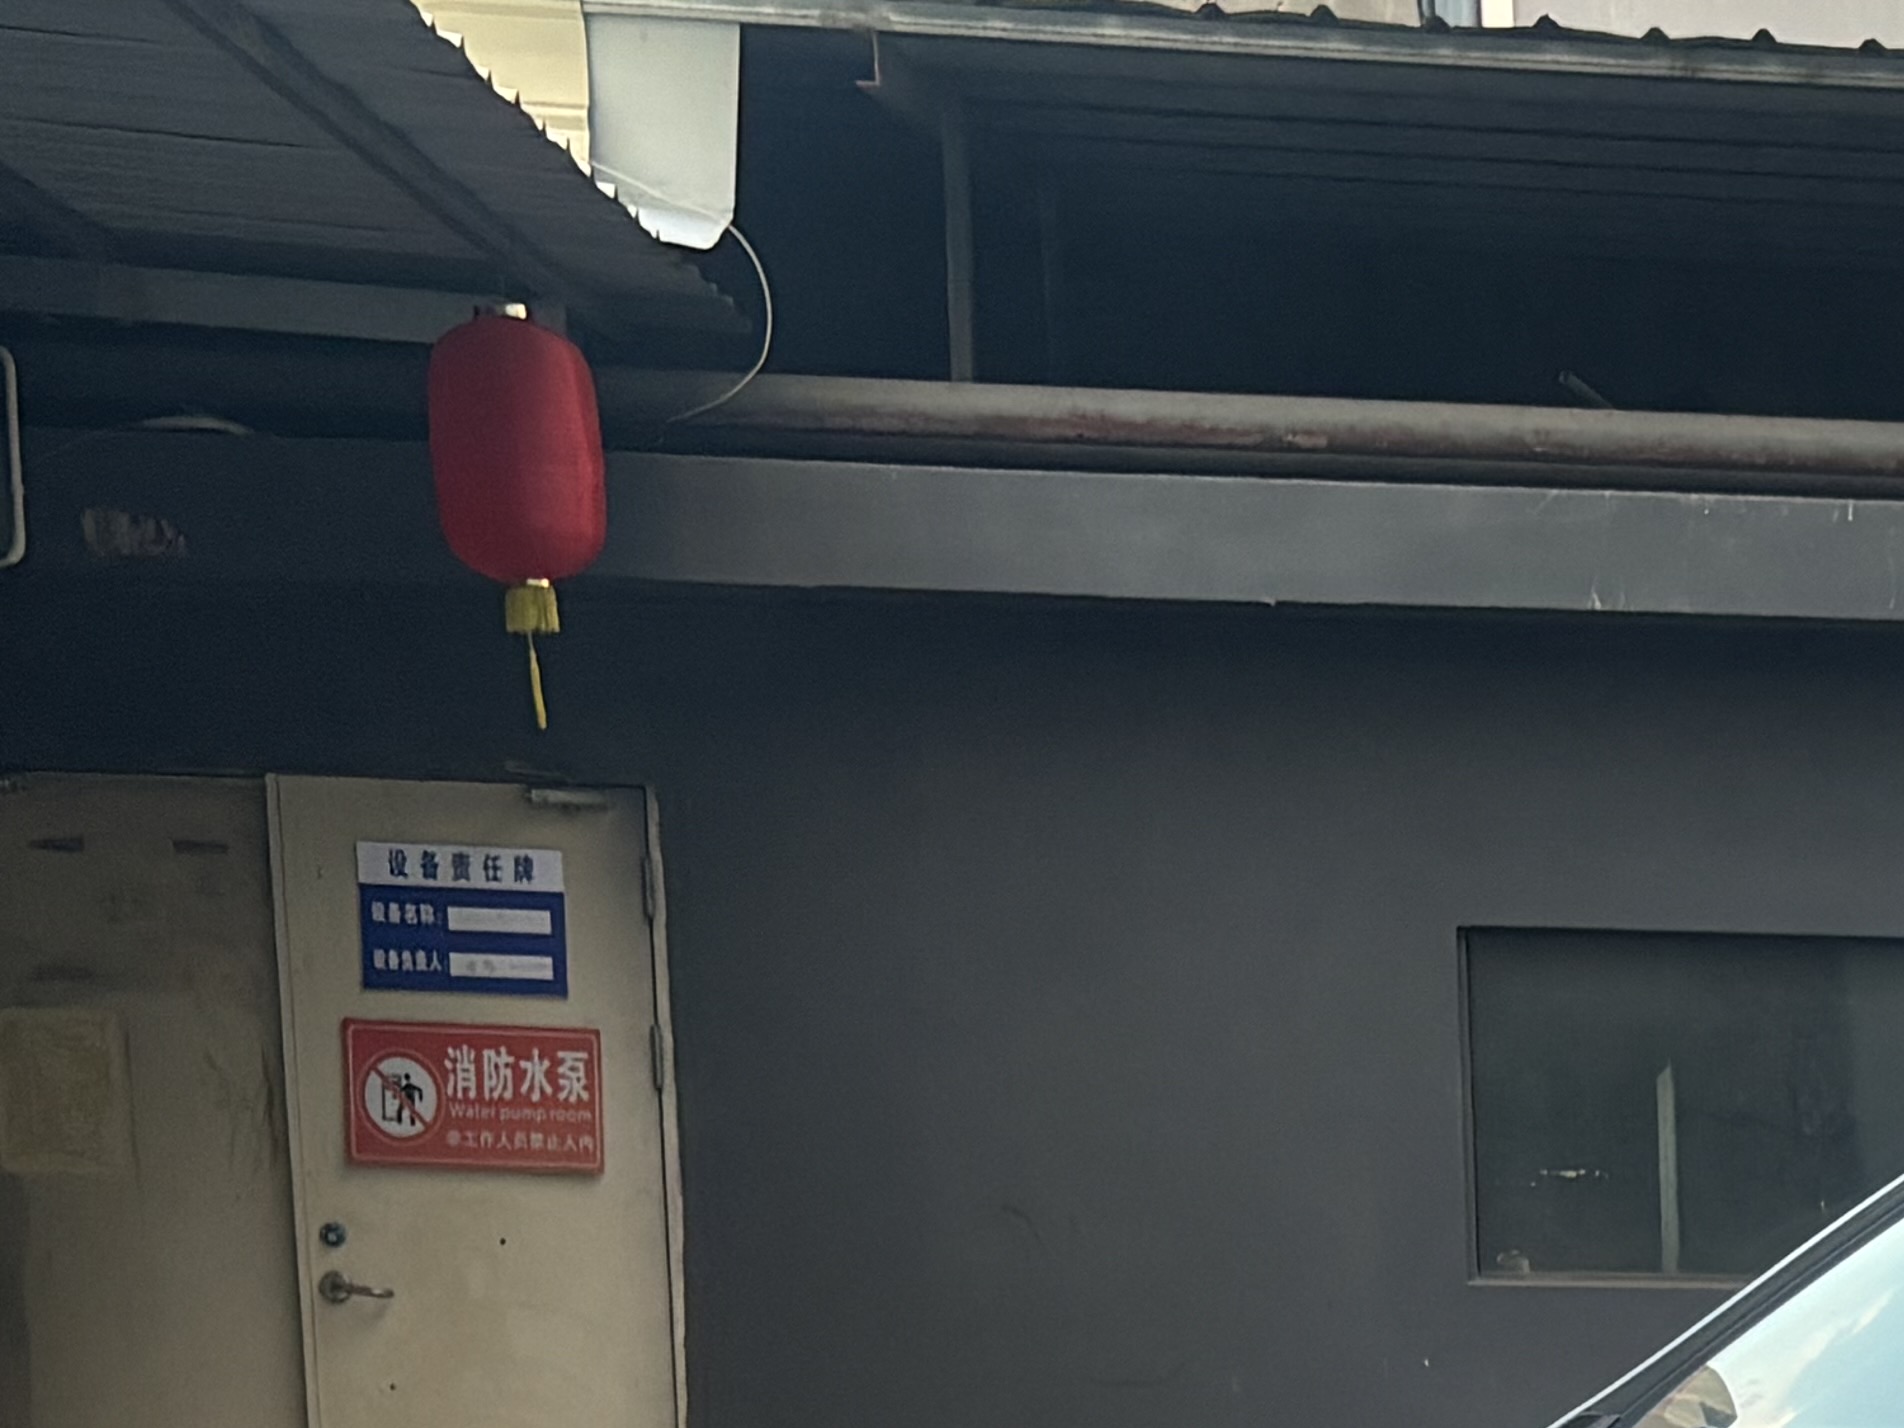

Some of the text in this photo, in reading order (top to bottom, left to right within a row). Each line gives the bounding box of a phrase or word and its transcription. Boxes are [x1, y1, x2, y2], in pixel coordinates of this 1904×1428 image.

[387, 848, 535, 884] 设备责任牌
[444, 1044, 590, 1103] 消防水泵
[449, 1101, 592, 1124] Water pump room
